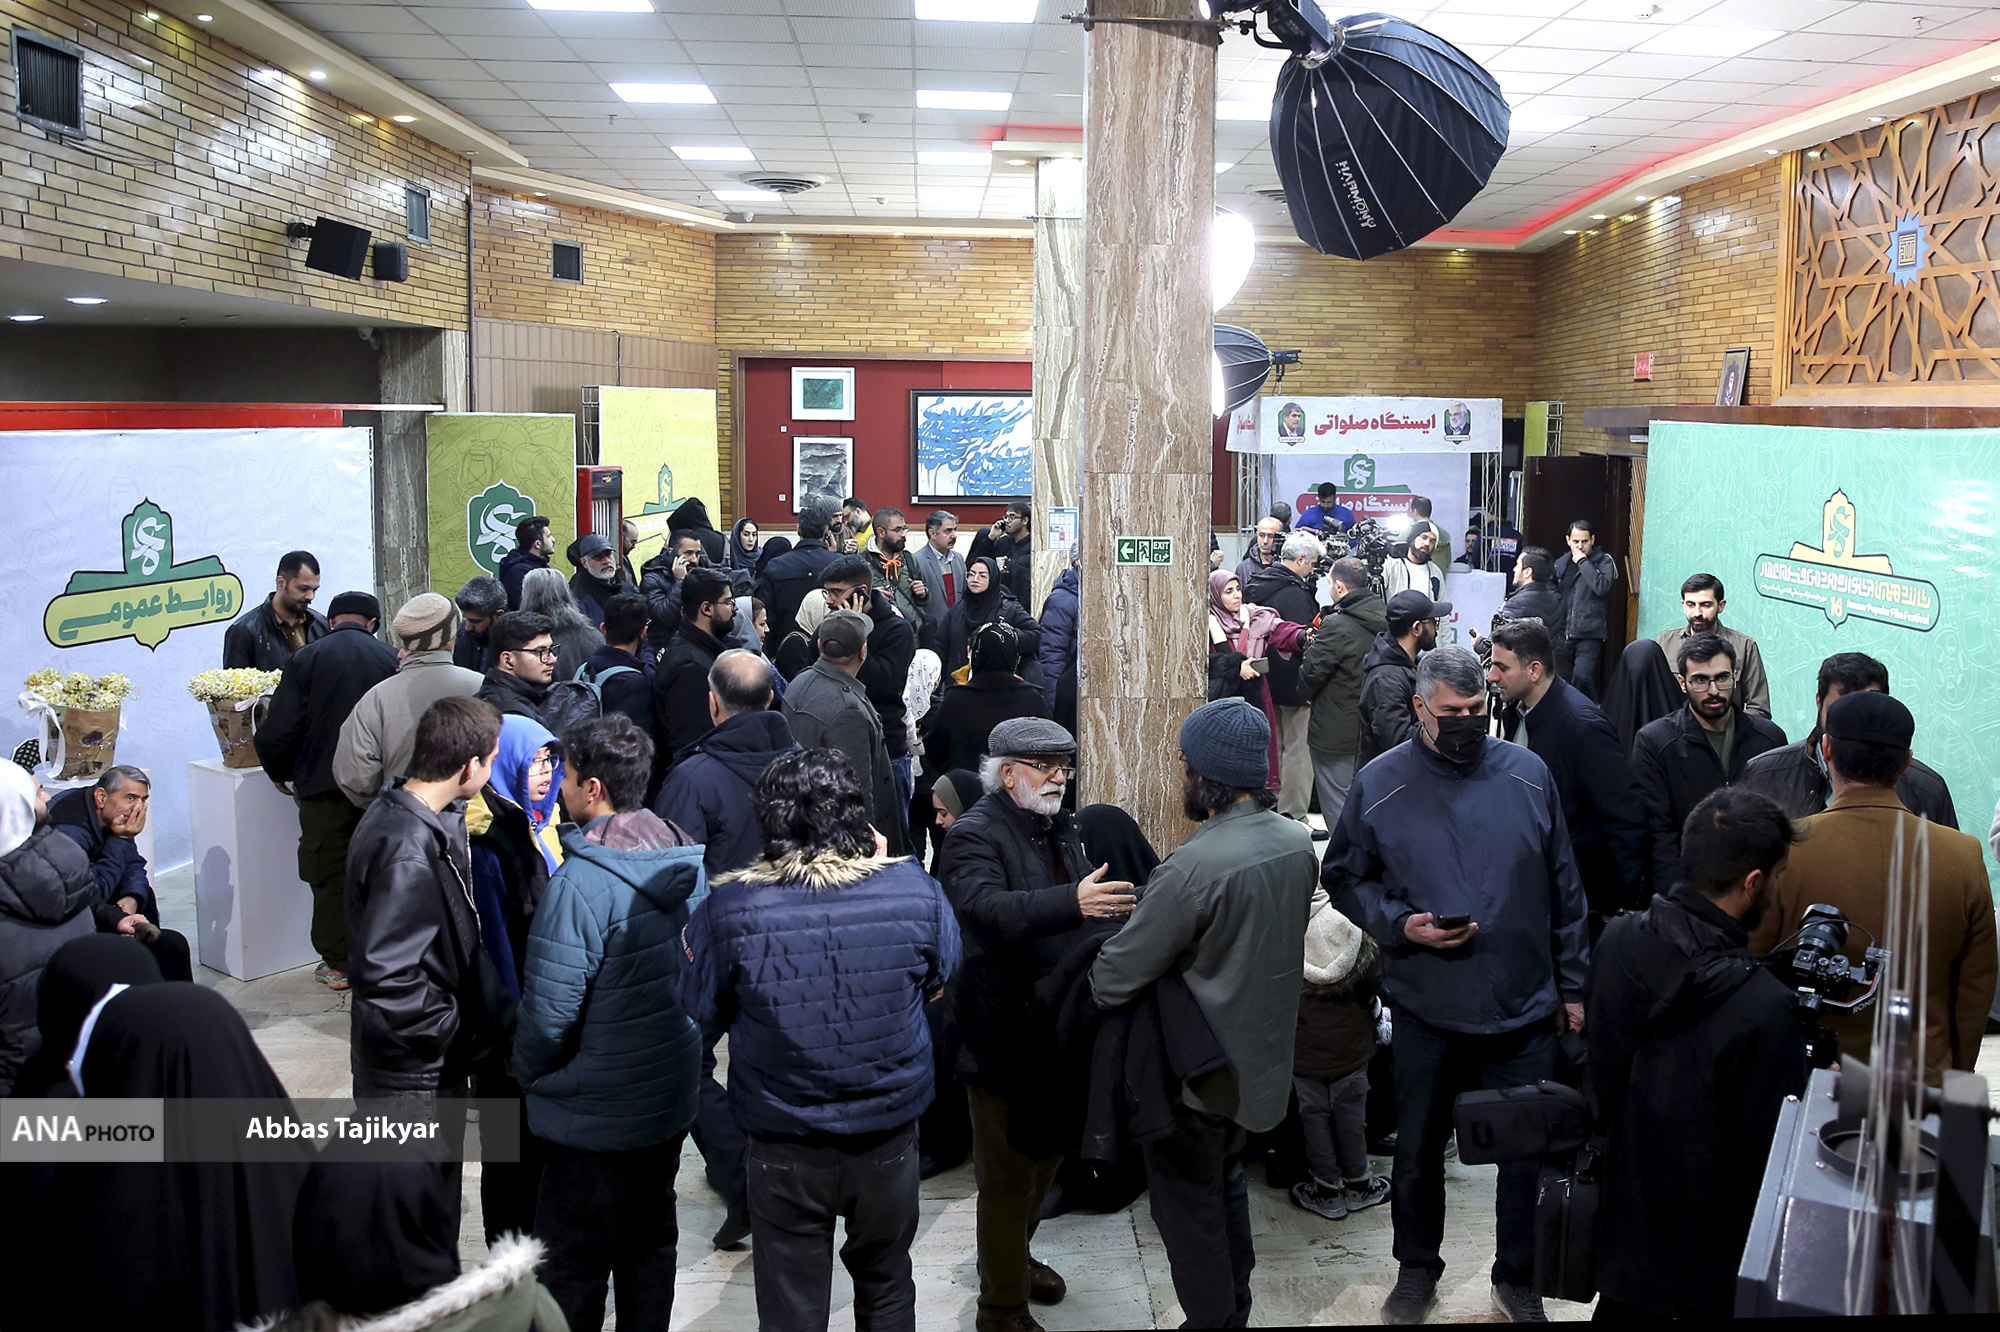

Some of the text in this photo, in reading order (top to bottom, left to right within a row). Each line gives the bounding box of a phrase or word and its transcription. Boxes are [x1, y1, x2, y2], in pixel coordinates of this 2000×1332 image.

[1338, 160, 1377, 228] HARMONY
[1314, 411, 1436, 435] ایستگاه صلواتی
[1153, 541, 1170, 550] EXIT
[1153, 551, 1170, 562] خروج
[58, 580, 233, 641] روابط عمومی
[1829, 595, 1844, 618] 16
